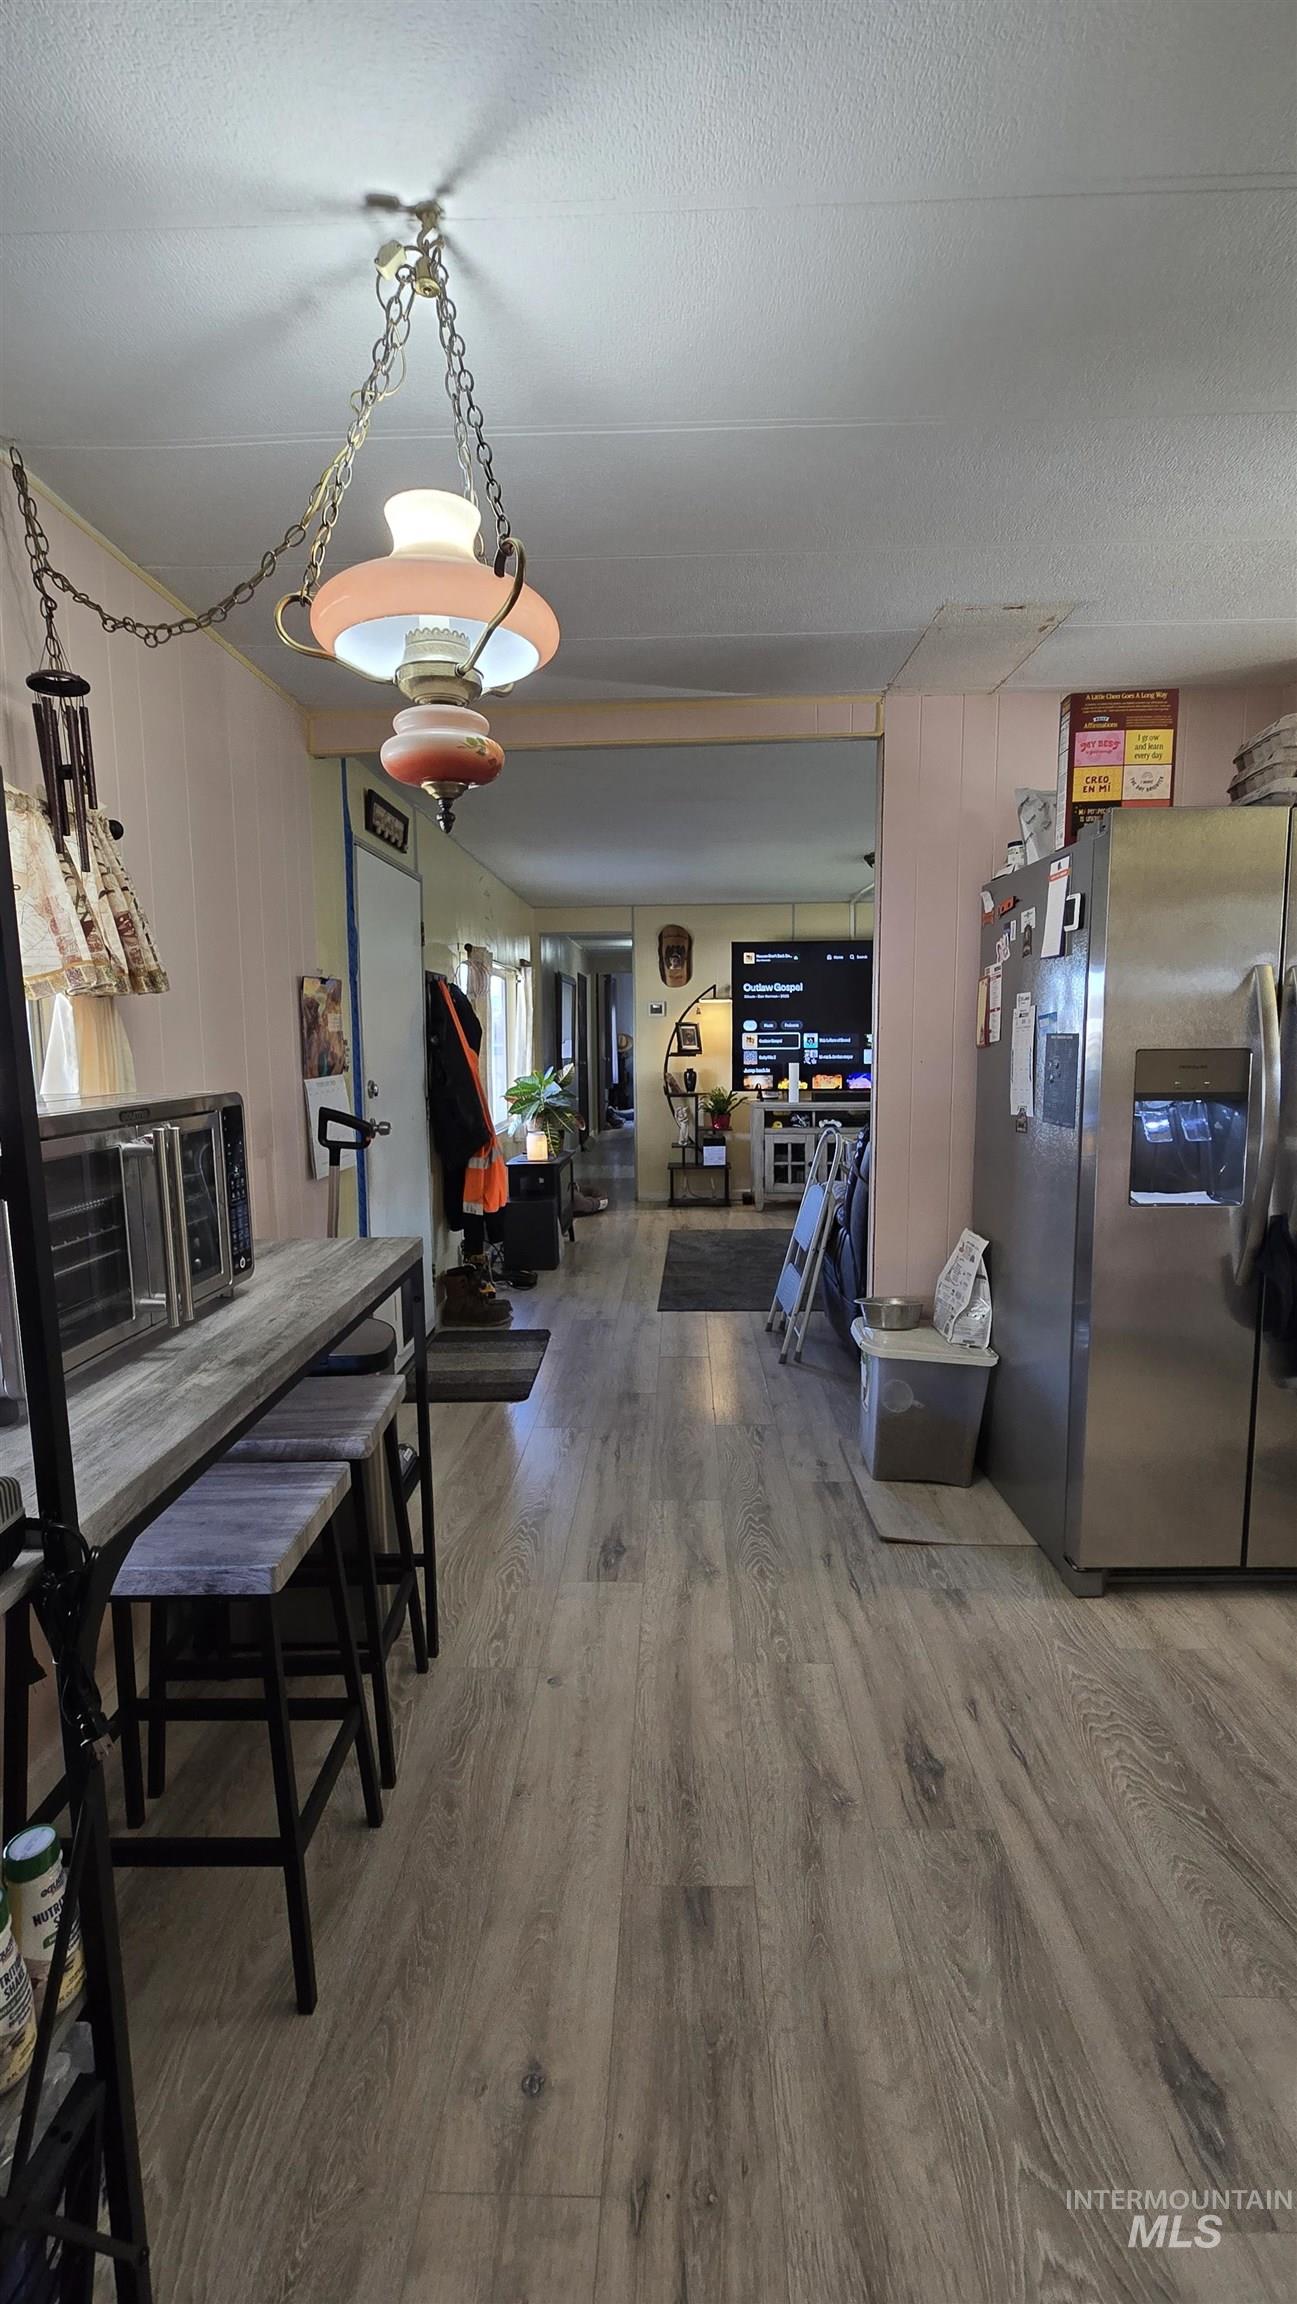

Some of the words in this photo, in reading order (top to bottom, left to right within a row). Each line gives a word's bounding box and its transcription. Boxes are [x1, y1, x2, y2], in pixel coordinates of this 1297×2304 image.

[1141, 691, 1155, 700] Long
[1156, 691, 1168, 700] Way
[1148, 742, 1164, 750] learn
[1134, 752, 1150, 760] every
[1151, 752, 1163, 760] day
[1085, 775, 1109, 785] CREO
[743, 982, 773, 992] Outlaw
[774, 982, 803, 993] Gospel
